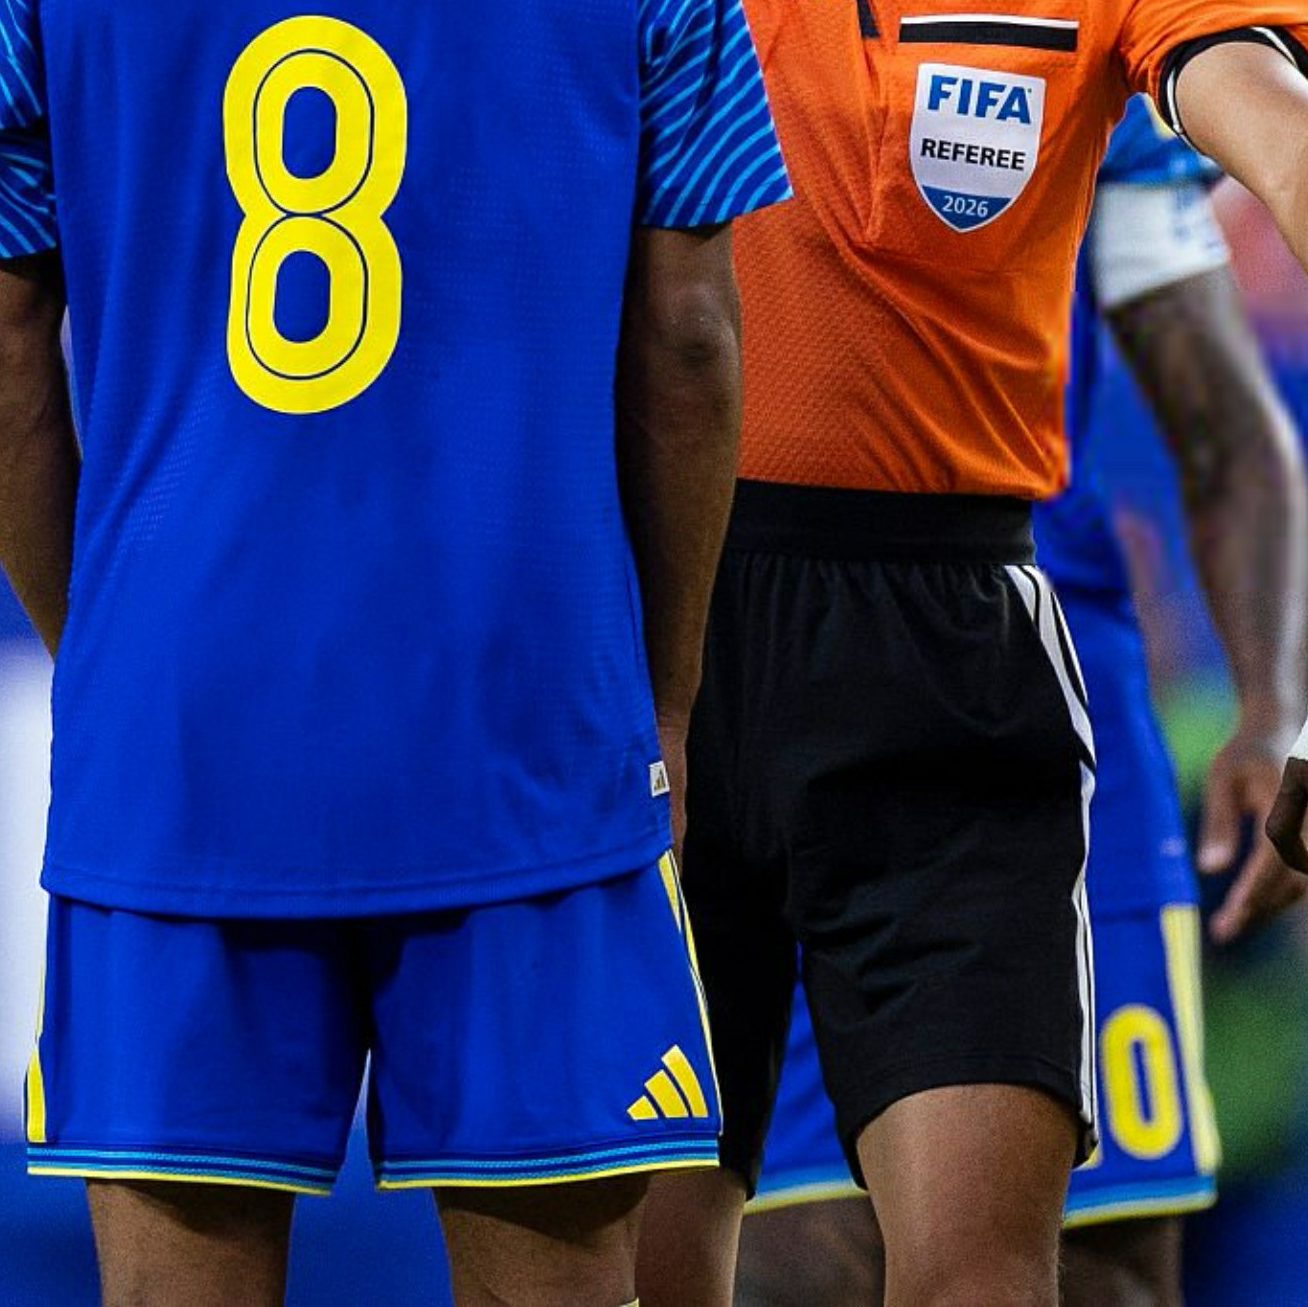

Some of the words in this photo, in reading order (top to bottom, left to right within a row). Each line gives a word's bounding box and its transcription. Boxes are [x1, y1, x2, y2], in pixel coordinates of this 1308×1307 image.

[927, 74, 1032, 125] FIFA
[920, 138, 1026, 171] REFEREE
[222, 14, 408, 415] 8
[942, 195, 989, 217] 2026
